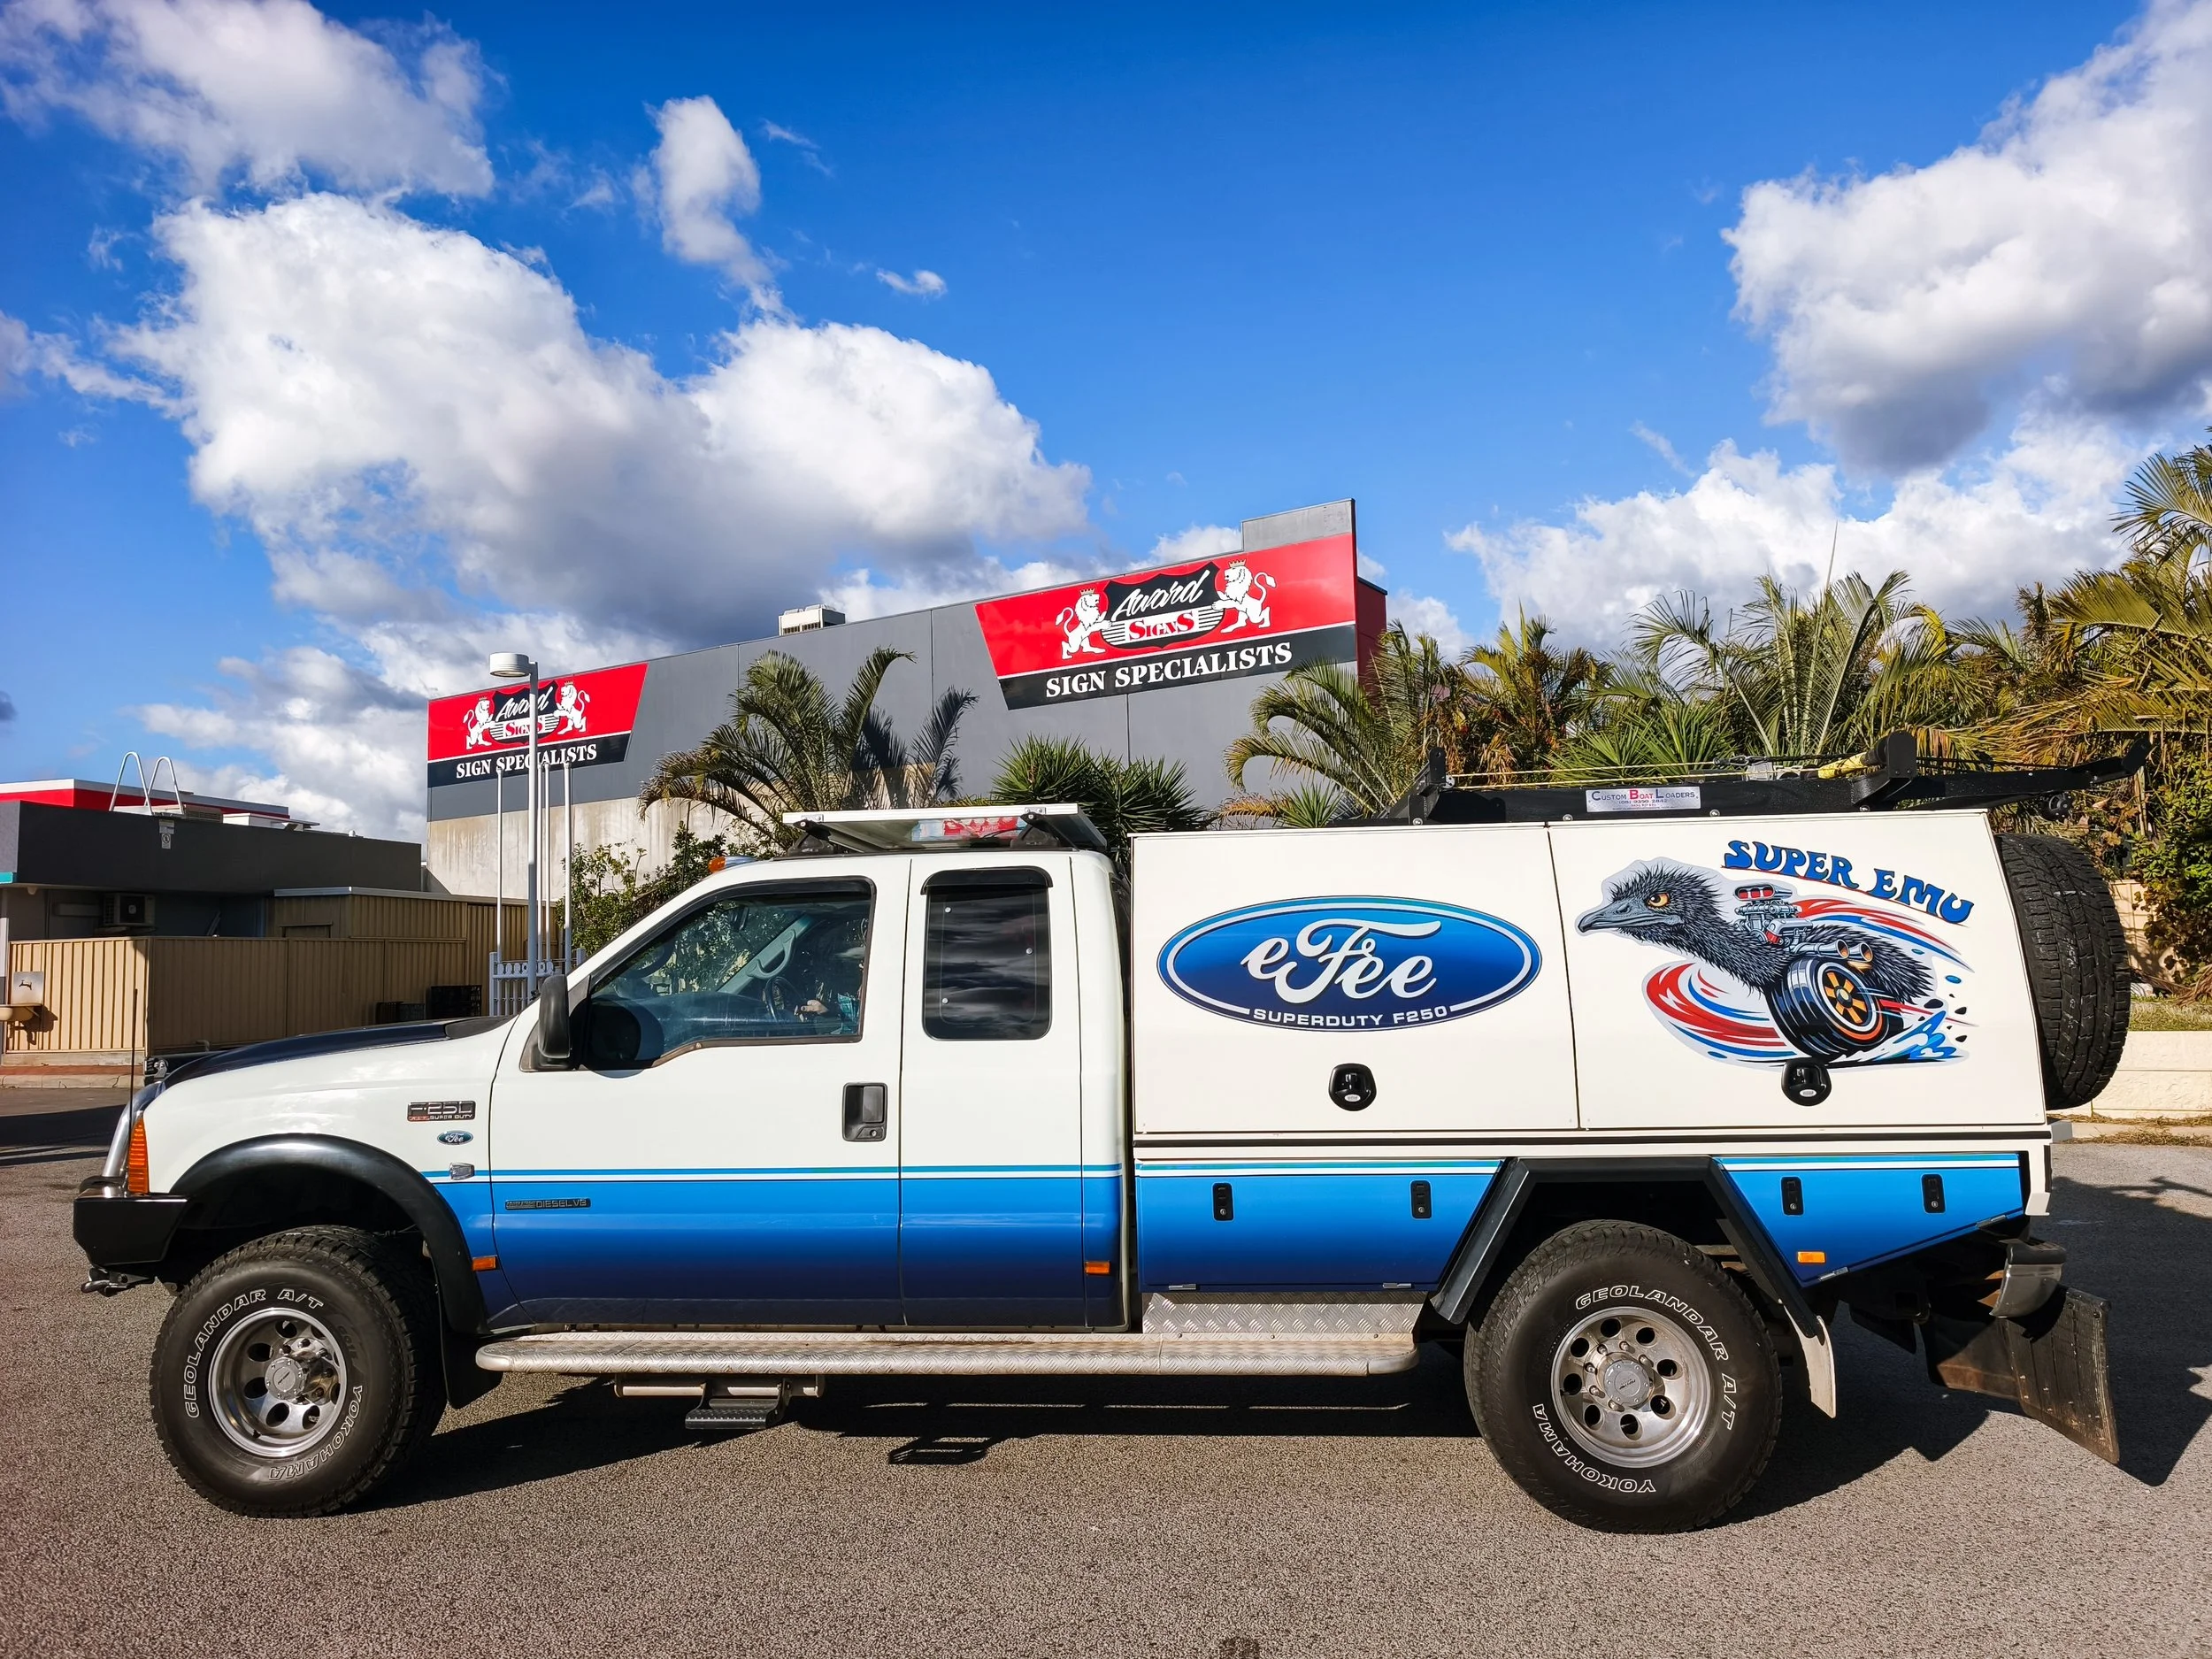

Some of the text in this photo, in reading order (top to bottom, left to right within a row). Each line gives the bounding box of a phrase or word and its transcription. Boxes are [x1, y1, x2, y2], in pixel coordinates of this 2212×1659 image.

[1111, 570, 1211, 621] Award
[1128, 611, 1194, 641] SIGNS
[1046, 641, 1293, 697] SIGN SPECIALISTS
[495, 686, 554, 722] Awad
[456, 759, 492, 779] SIGN
[1591, 788, 1695, 801] CUSTOM BOAT LOADERS
[1724, 840, 1975, 925] SUPER EMU
[1240, 918, 1442, 1004] eFee
[1253, 1005, 1448, 1027] SUPERDUTY F250
[535, 1200, 572, 1209] DIESEL
[183, 1288, 266, 1418] GEOLANDAR
[277, 1288, 324, 1310] A/T
[1575, 1285, 1729, 1361] GEOLANDAR
[1721, 1372, 1737, 1430] A/T
[268, 1385, 363, 1480] YOKOHAMA
[1532, 1403, 1656, 1493] YOKOHAMA
